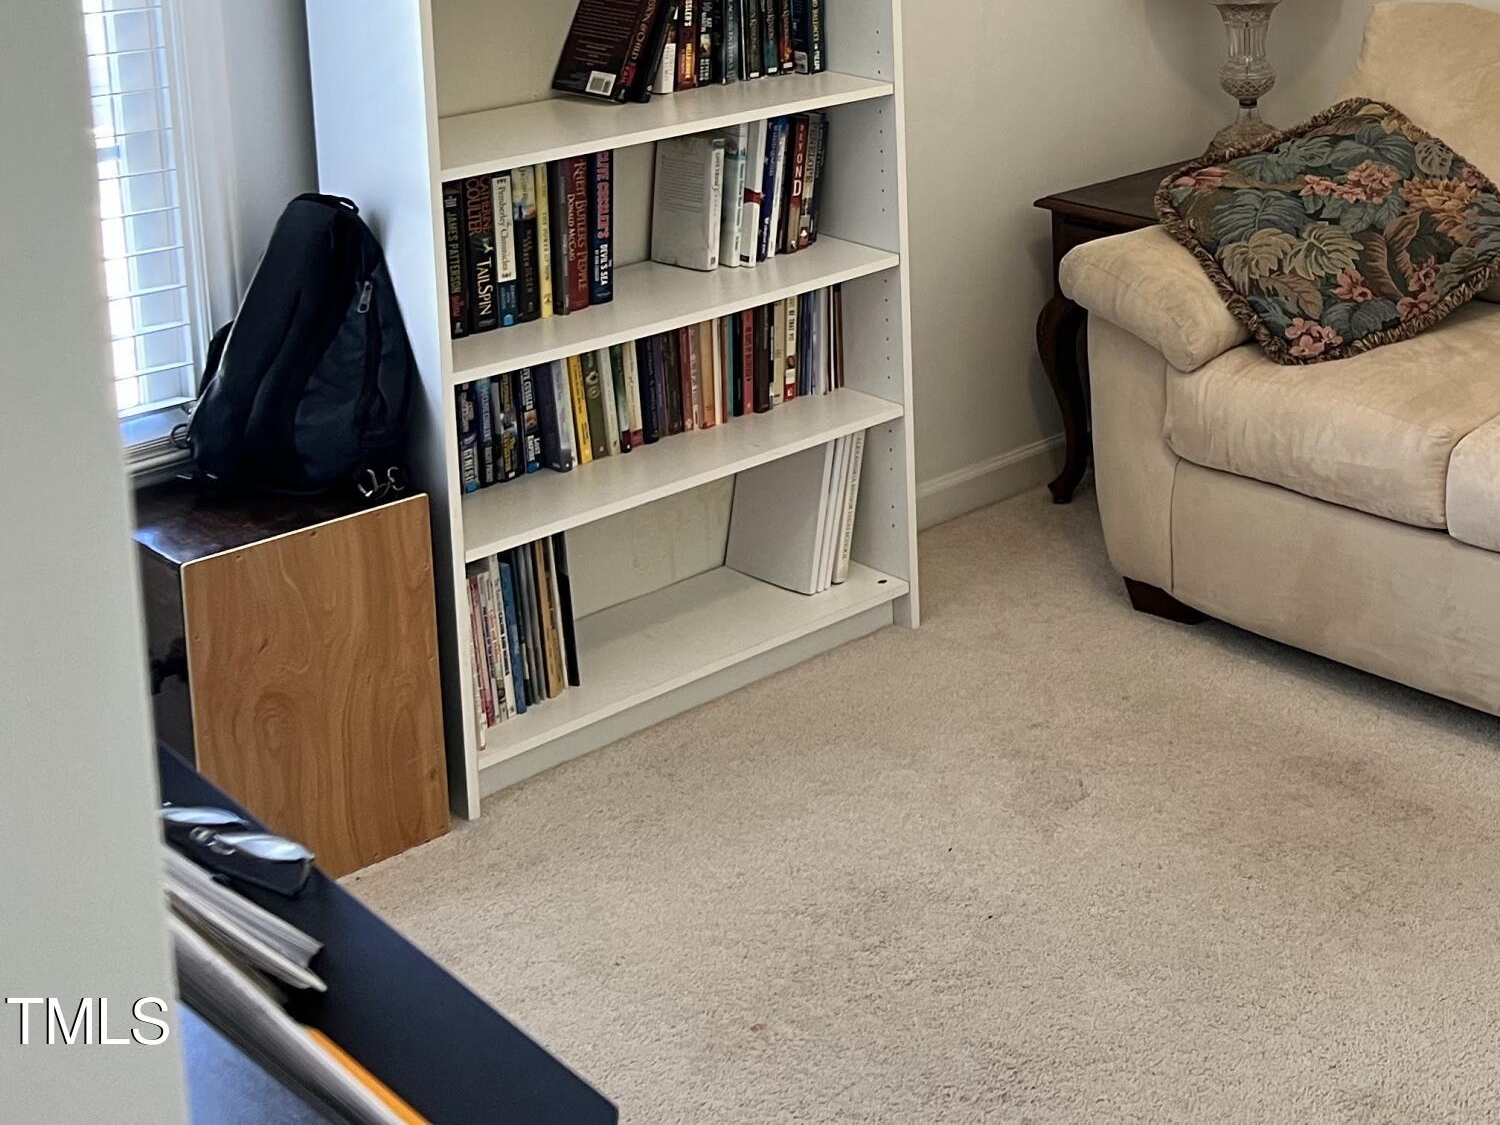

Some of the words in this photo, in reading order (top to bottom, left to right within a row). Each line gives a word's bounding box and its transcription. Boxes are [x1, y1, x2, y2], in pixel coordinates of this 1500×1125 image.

[792, 124, 804, 197] BEYOND
[806, 122, 818, 184] PENELOPE
[447, 212, 459, 241] JAMES
[466, 178, 482, 236] COULTER
[498, 187, 508, 227] Pemberley
[568, 194, 576, 227] DONALD
[449, 243, 461, 293] PATTERSON
[600, 244, 608, 270] DEVIL'S
[476, 257, 493, 315] TAILSPIN
[600, 271, 608, 286] SEA
[524, 381, 533, 410] CUSSLER
